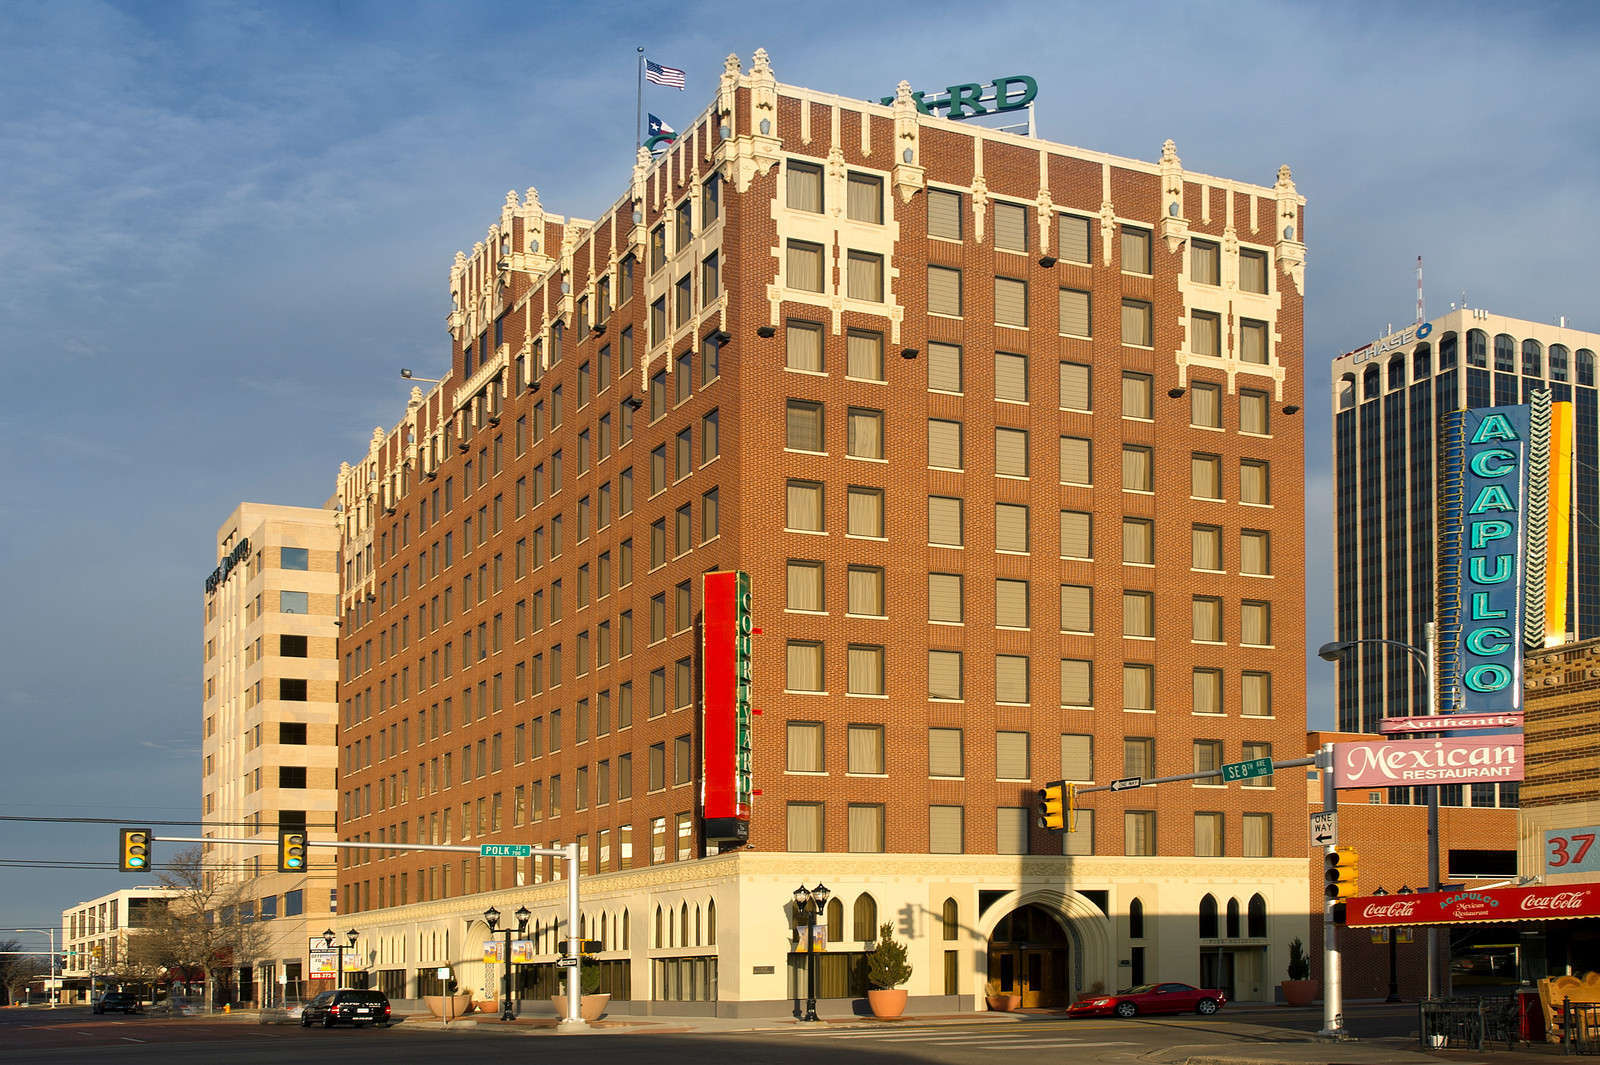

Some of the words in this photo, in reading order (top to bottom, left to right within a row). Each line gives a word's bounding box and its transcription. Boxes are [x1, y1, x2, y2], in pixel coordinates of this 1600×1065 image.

[1354, 330, 1415, 365] CHASE
[1464, 412, 1520, 694] ACAPULCO
[1392, 715, 1519, 730] Authentic
[1346, 741, 1518, 781] Mexican
[1228, 765, 1241, 779] SE
[1402, 766, 1514, 780] RESTAURANT
[1314, 814, 1332, 823] ONE
[1314, 823, 1333, 832] WAY
[485, 846, 510, 855] POLK
[1548, 834, 1596, 867] 37
[1440, 892, 1499, 909] ACAPULCO
[1521, 891, 1586, 911] Coca-Cola
[1363, 901, 1416, 918] Coca-Cola
